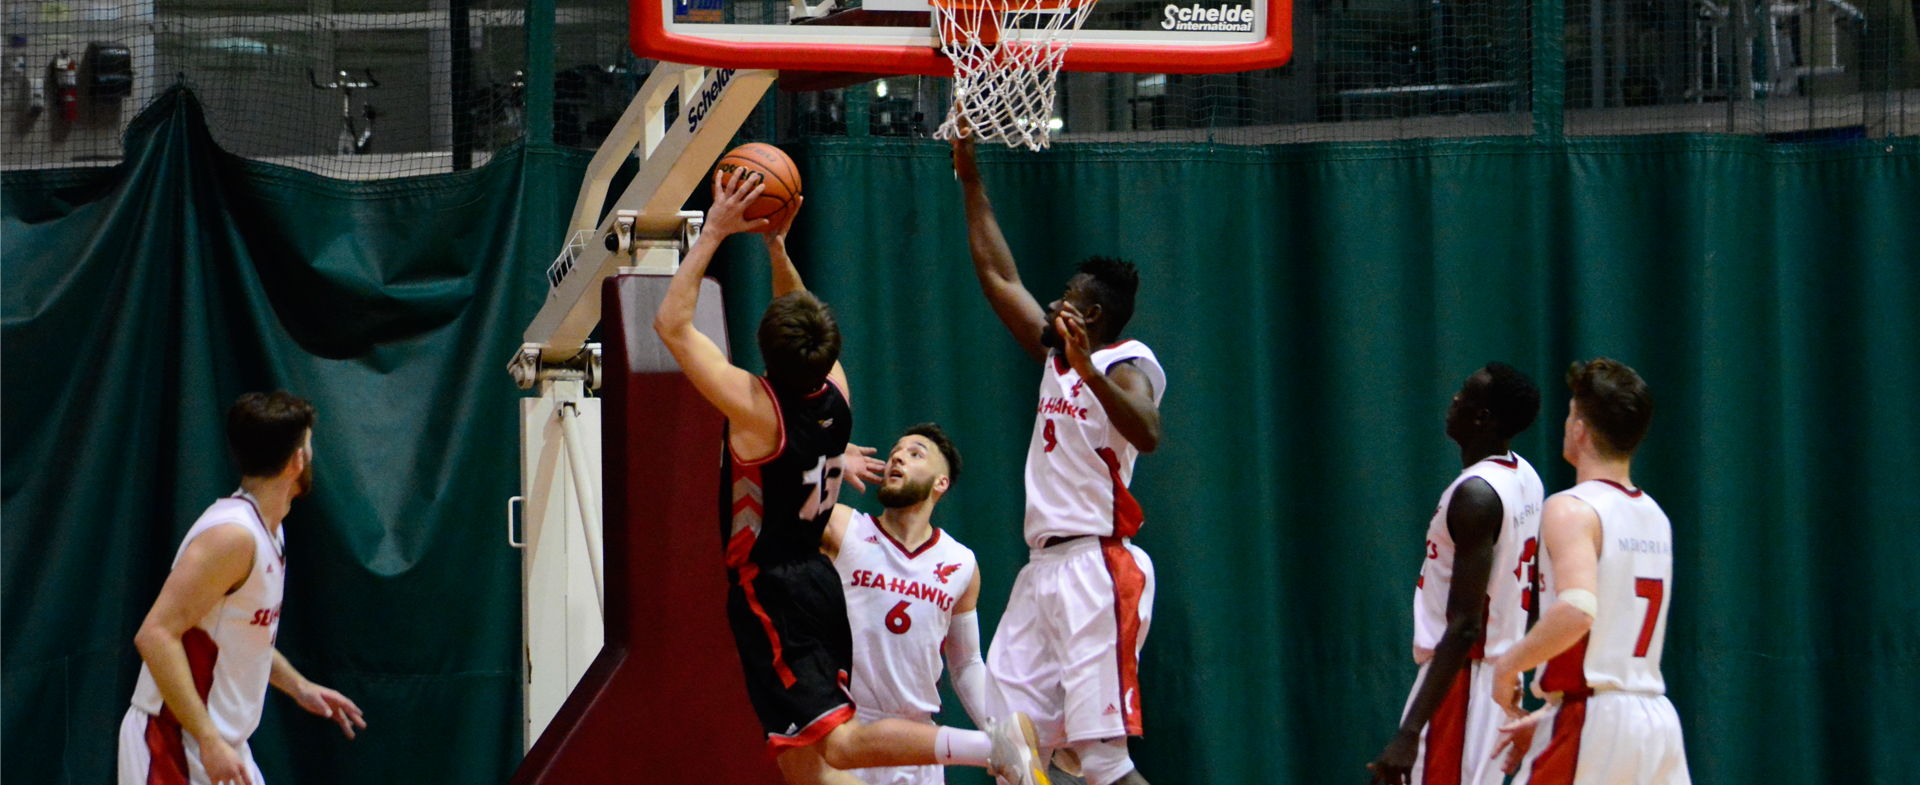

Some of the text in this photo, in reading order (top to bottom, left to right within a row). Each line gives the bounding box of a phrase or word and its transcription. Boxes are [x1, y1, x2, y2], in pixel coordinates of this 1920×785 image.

[1161, 4, 1254, 30] Schelde
[1176, 20, 1252, 31] international
[1043, 418, 1058, 453] 9
[884, 599, 912, 635] 6
[1632, 576, 1664, 657] 7
